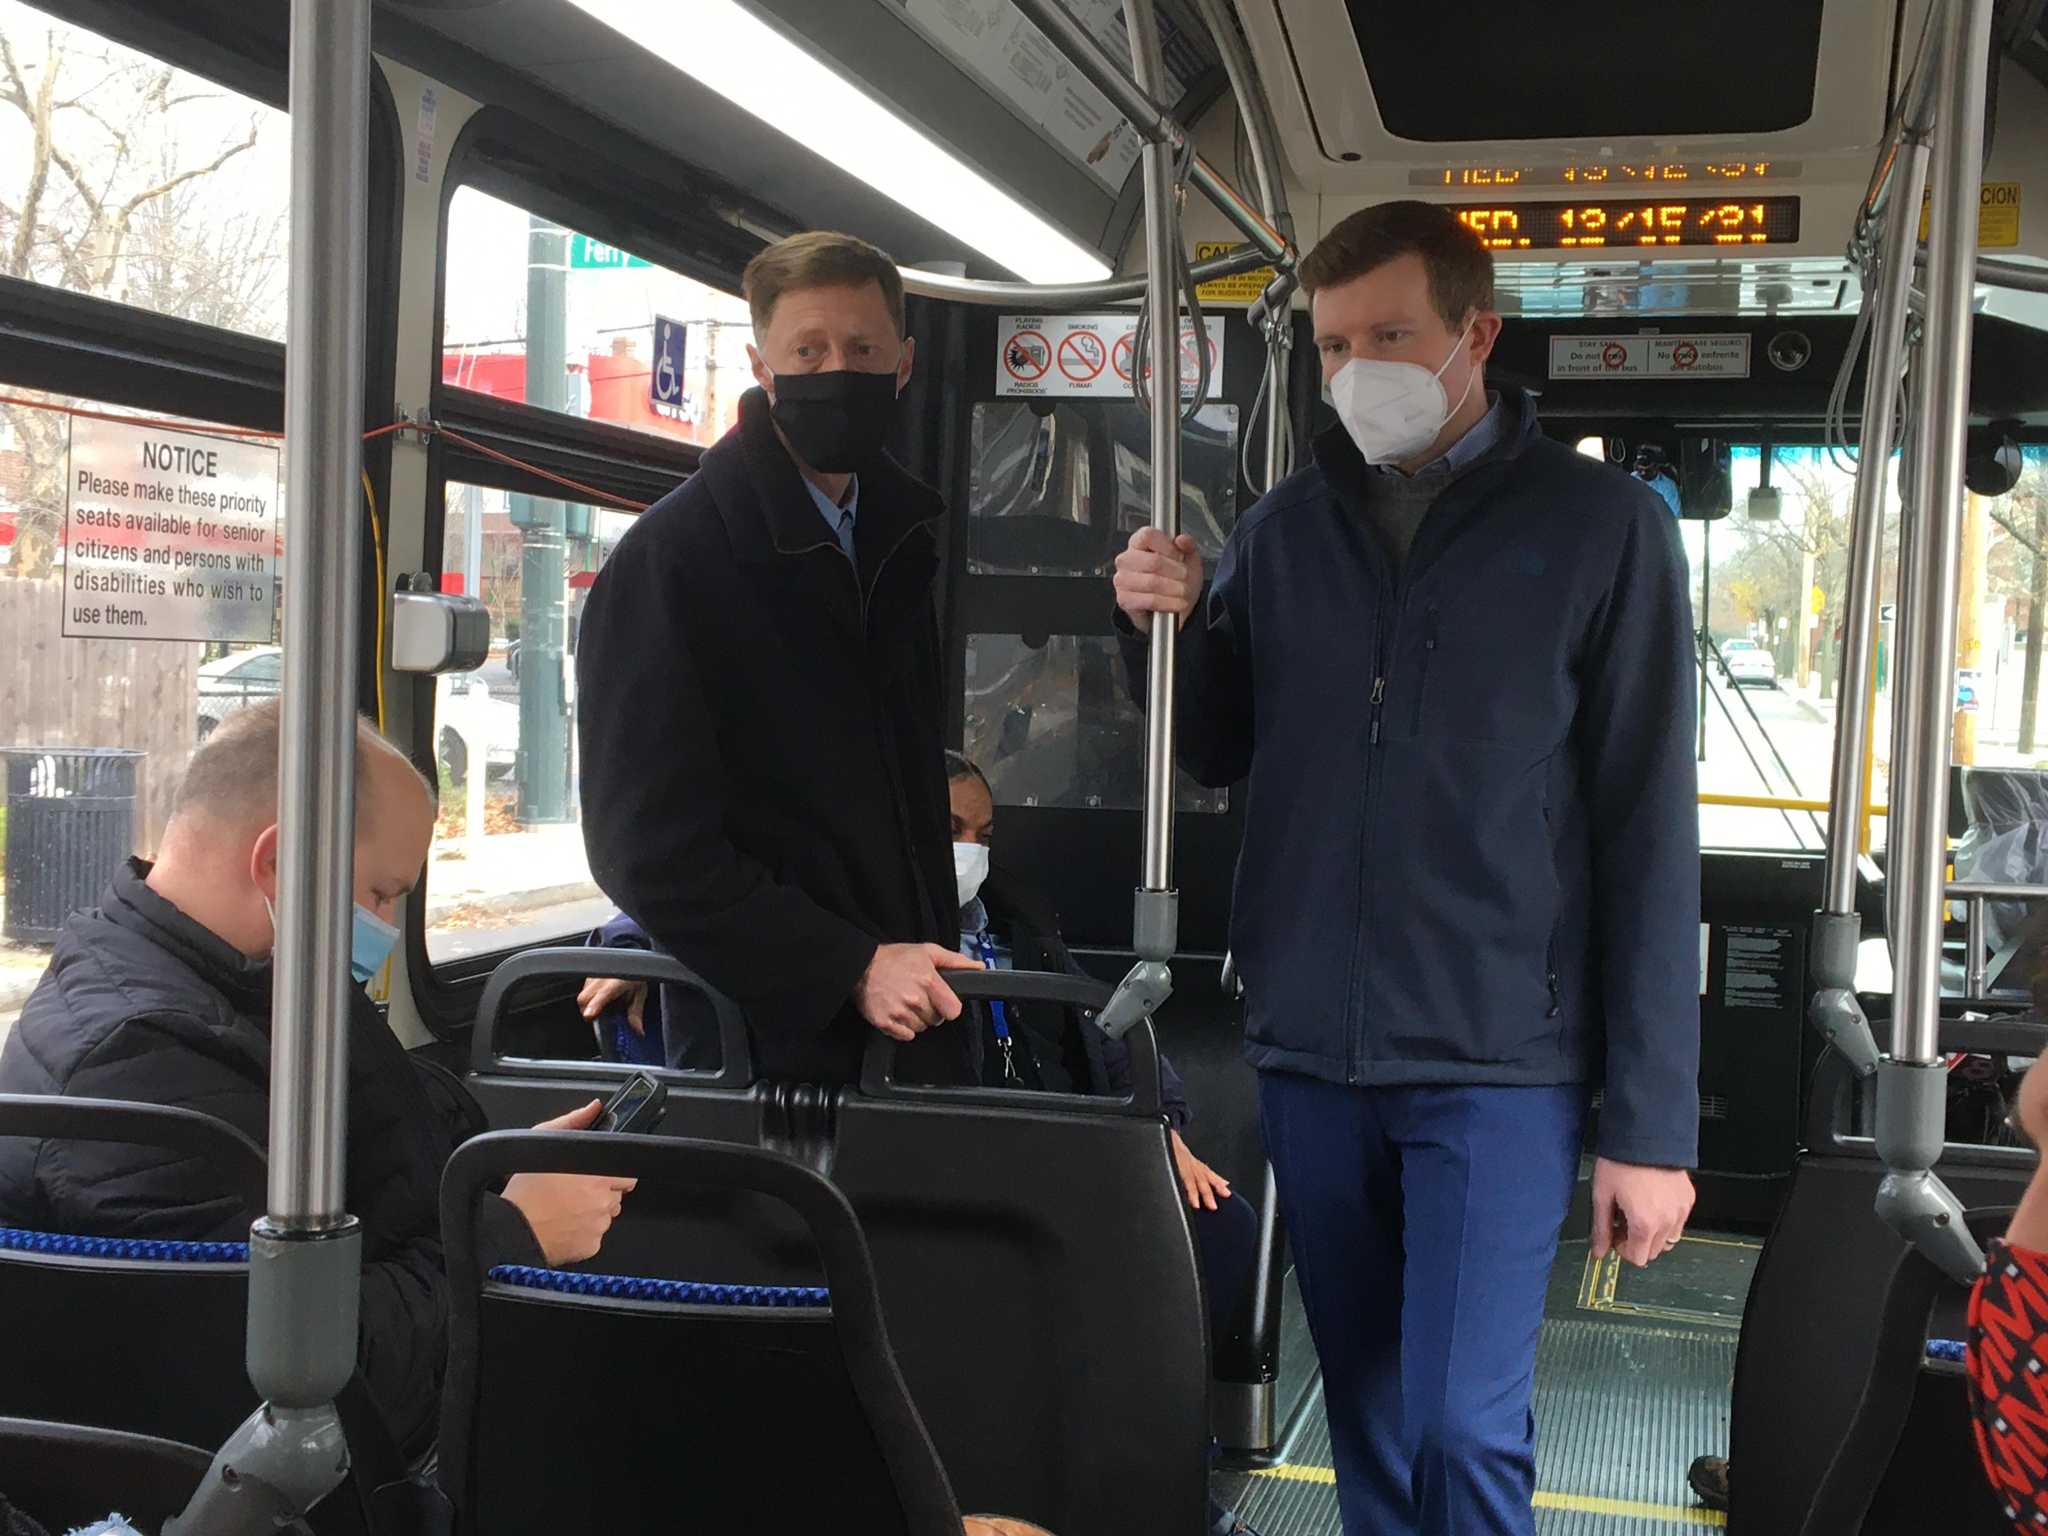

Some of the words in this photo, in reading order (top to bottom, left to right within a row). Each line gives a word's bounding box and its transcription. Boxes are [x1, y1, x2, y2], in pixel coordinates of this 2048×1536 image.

[1459, 208, 1531, 246] ED.
[584, 236, 630, 267] Ferry
[1068, 323, 1098, 331] SMOKING
[1557, 363, 1566, 372] in
[1568, 363, 1591, 373] front
[1592, 364, 1602, 373] of
[1622, 363, 1638, 373] bus
[1570, 351, 1583, 361] Do
[1584, 351, 1600, 361] not
[1657, 351, 1671, 361] No
[1701, 350, 1740, 360] enfrente
[143, 441, 218, 478] NOTICE
[77, 470, 129, 497] Please
[134, 481, 174, 503] make
[178, 485, 216, 508] these
[220, 492, 266, 518] priority
[76, 507, 121, 529] seats
[126, 512, 191, 535] available
[197, 517, 218, 538] for
[223, 524, 266, 543] senior
[75, 537, 138, 562] citizens
[143, 545, 170, 565] and
[174, 550, 231, 571] persons
[235, 554, 264, 573] with
[74, 570, 166, 595] disabilities
[173, 578, 204, 598] who
[211, 581, 243, 601] wish
[249, 583, 263, 602] to
[73, 606, 101, 624] use
[105, 604, 148, 626] them.
